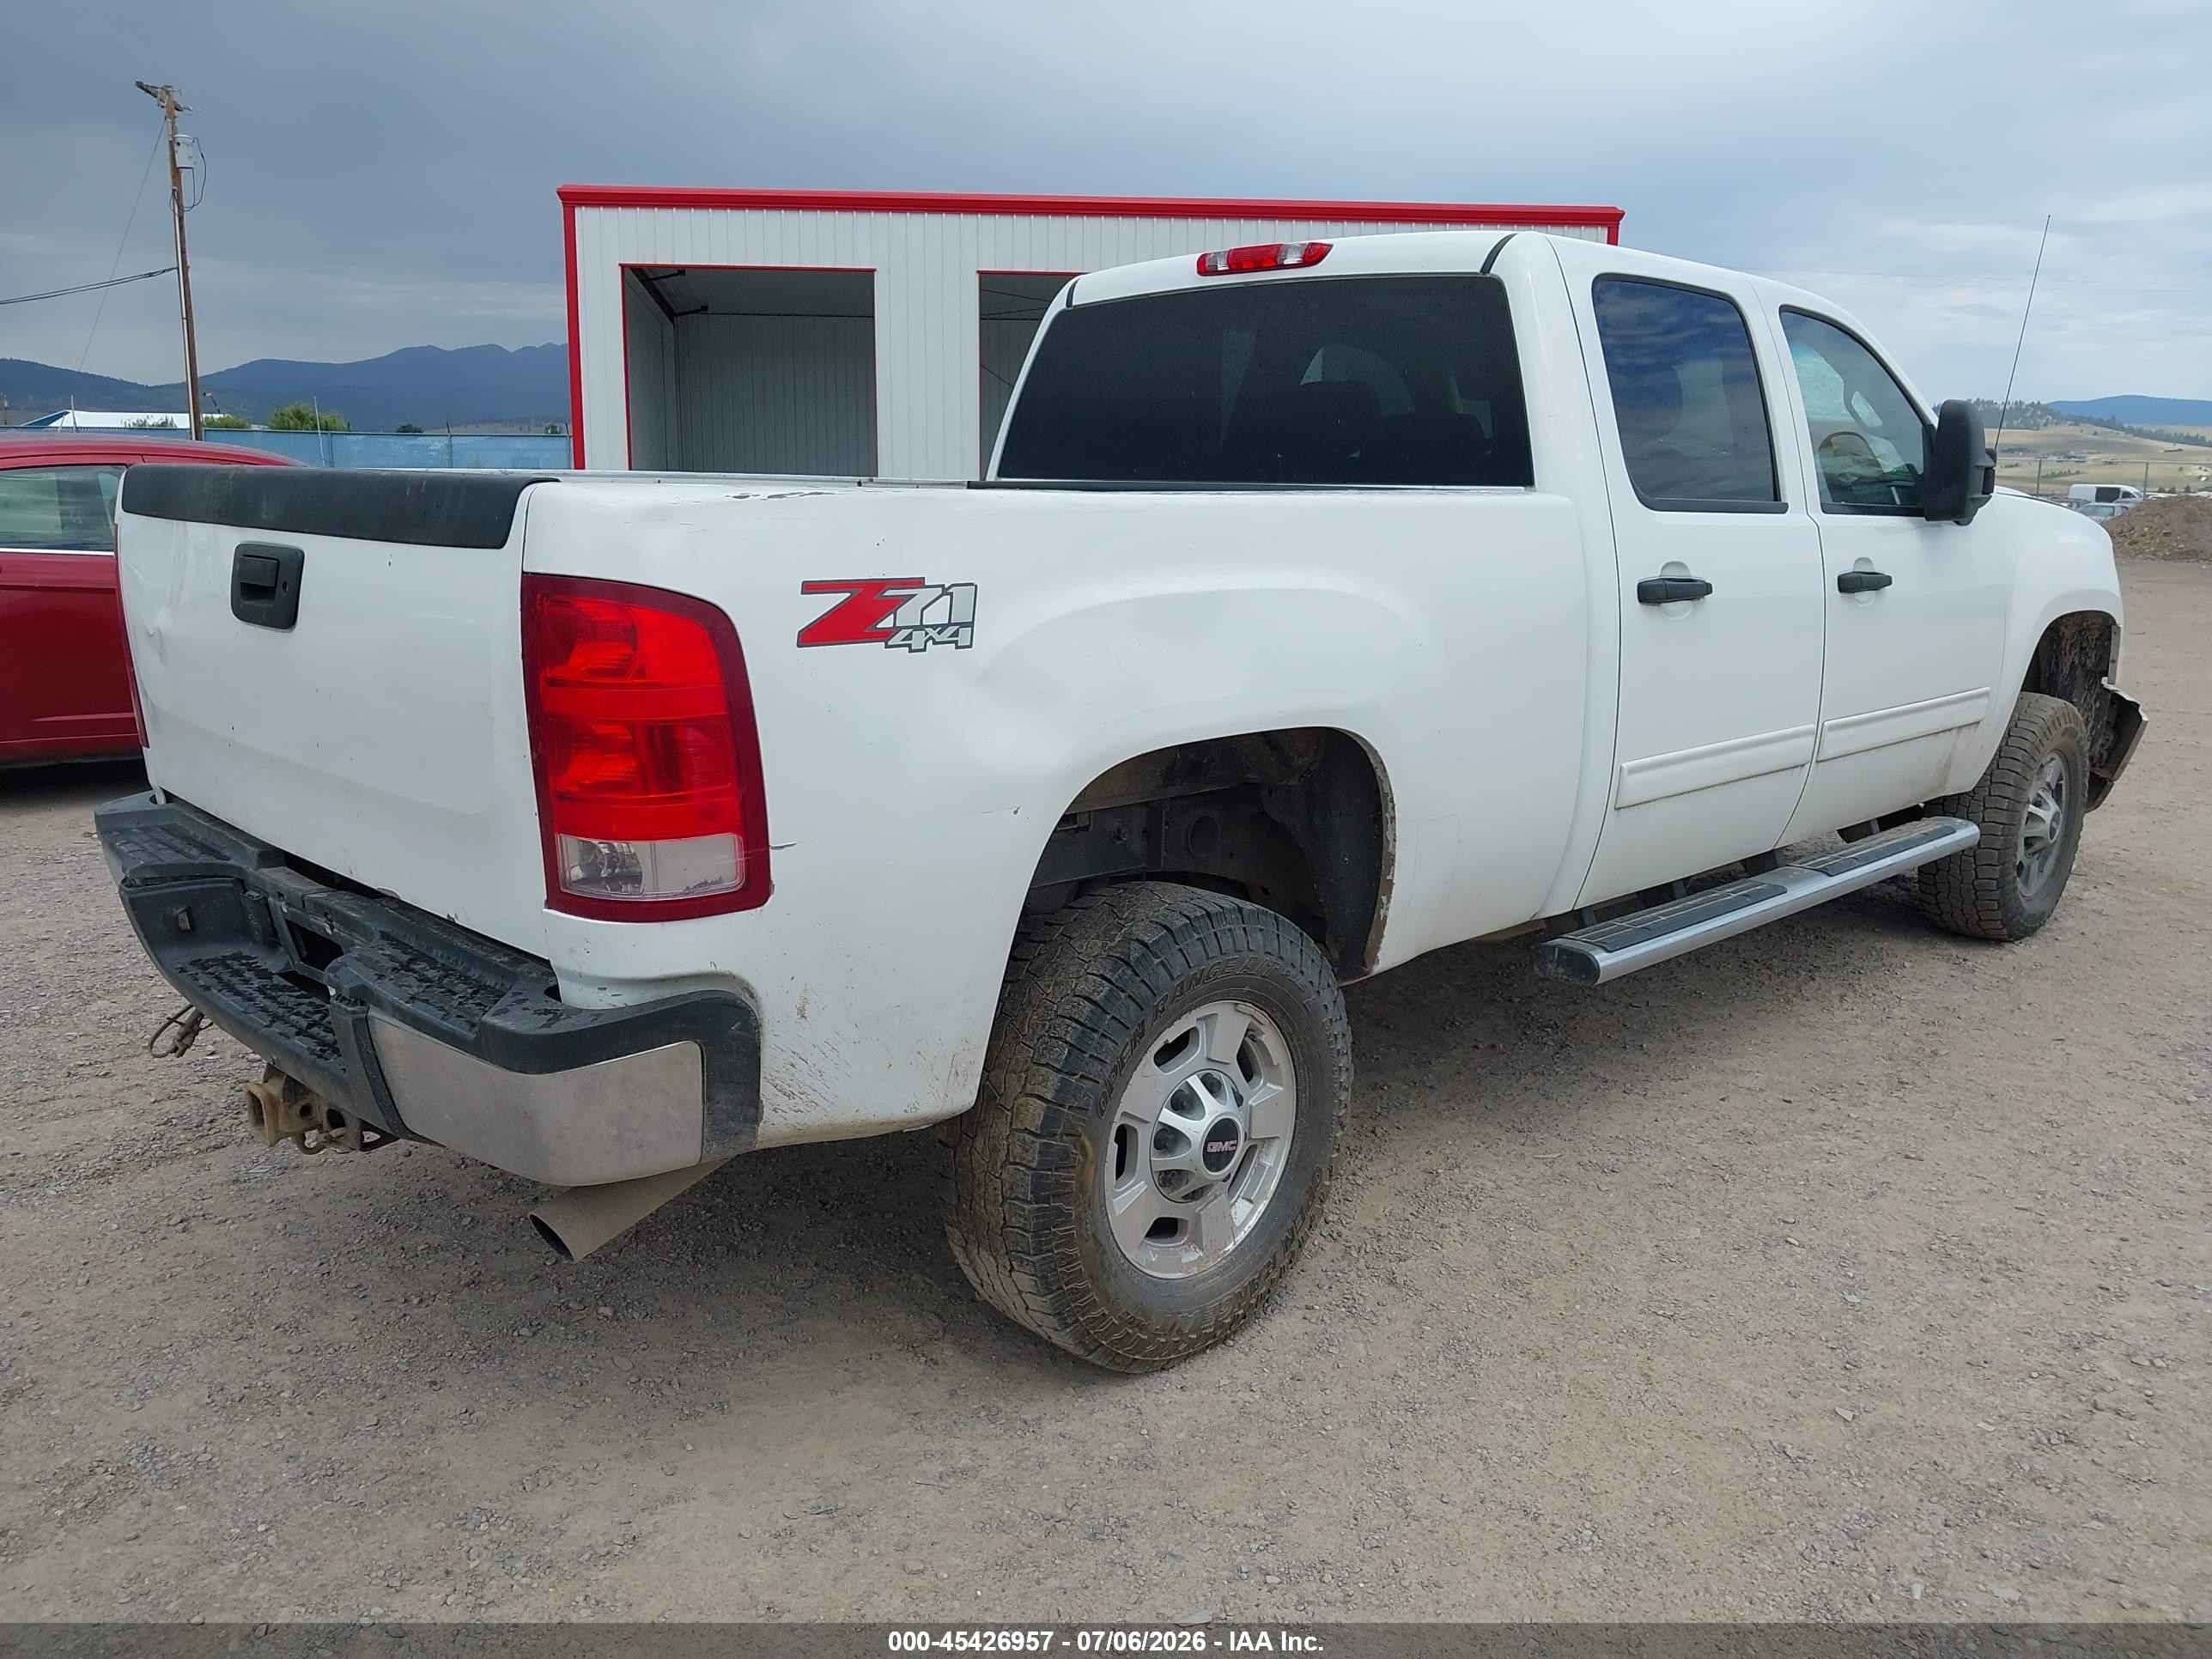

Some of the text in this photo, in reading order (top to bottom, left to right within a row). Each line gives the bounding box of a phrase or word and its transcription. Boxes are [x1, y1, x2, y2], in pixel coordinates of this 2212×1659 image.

[797, 576, 977, 647] Z71
[1152, 955, 1239, 1028] RANGE
[1207, 1140, 1237, 1152] GMC
